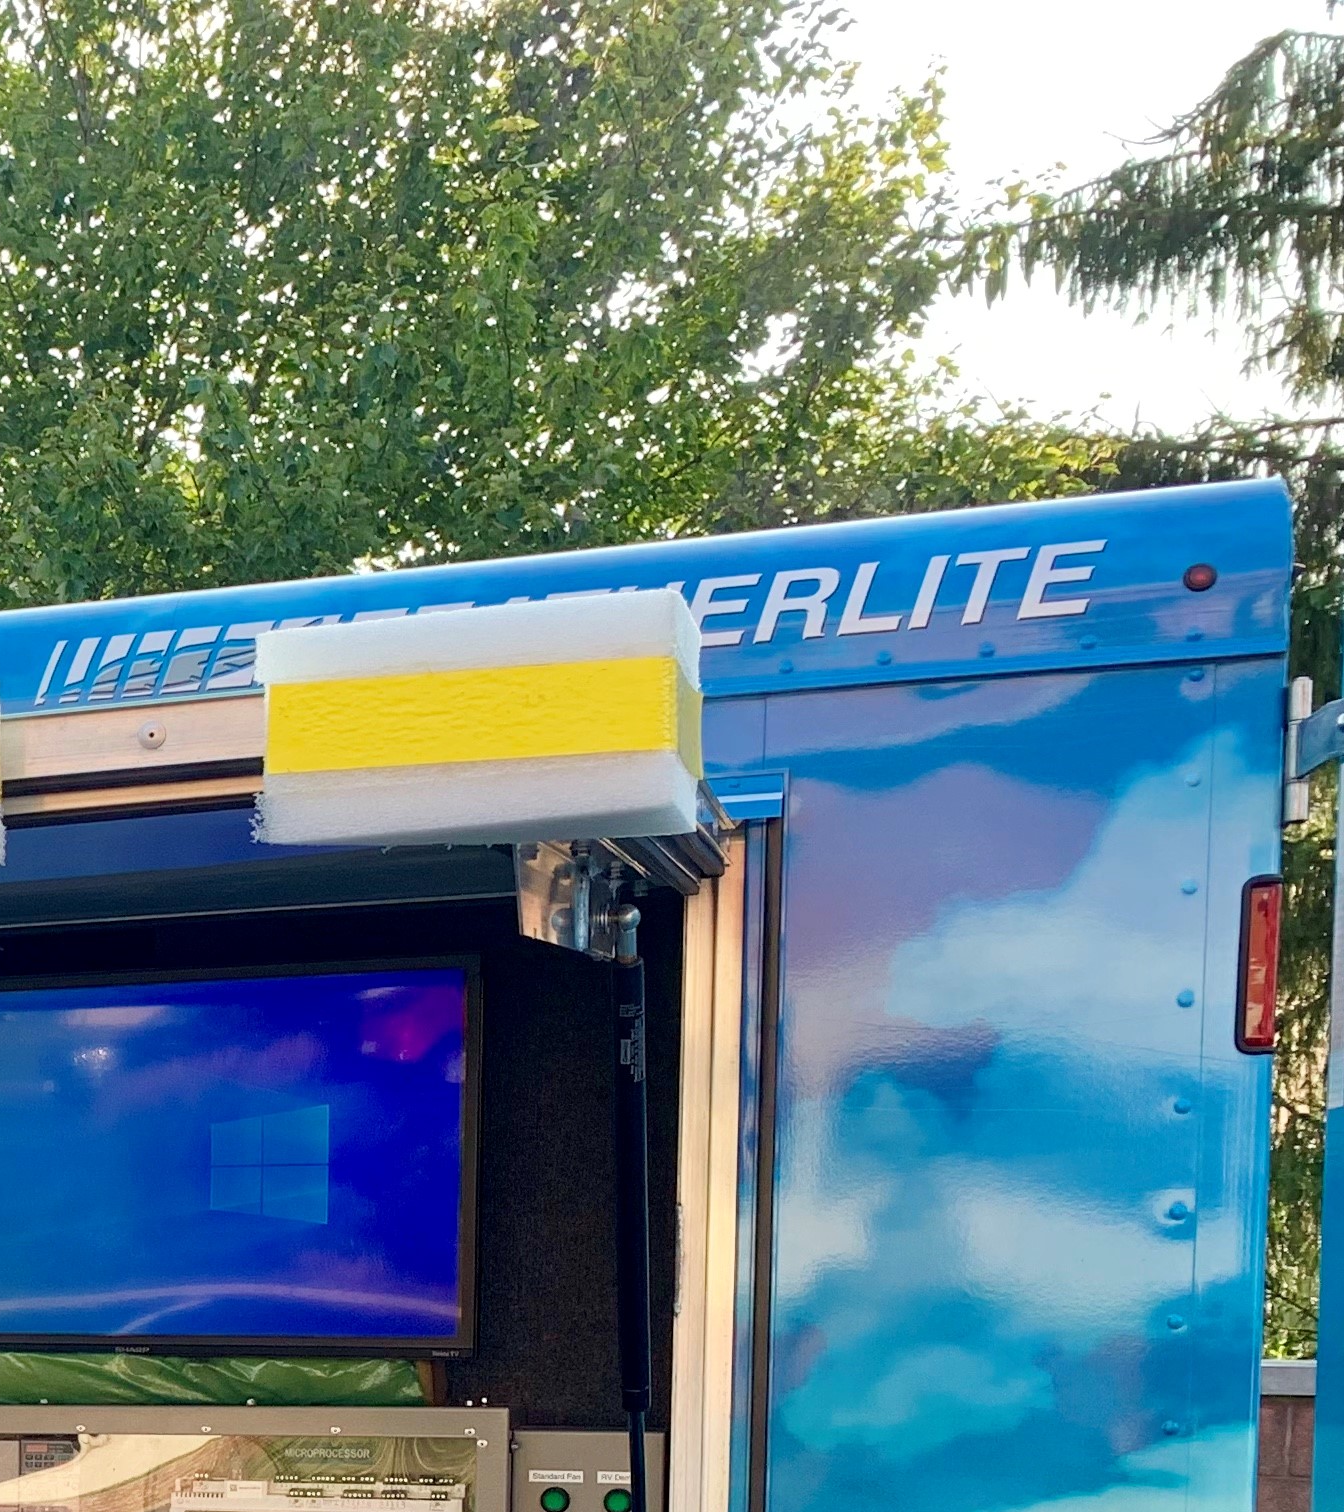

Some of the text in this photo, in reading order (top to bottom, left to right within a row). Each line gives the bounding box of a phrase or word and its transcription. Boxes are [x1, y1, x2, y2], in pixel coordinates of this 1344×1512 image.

[350, 539, 1108, 648] ERLITE
[284, 1448, 370, 1459] MICROPROCESSOR
[532, 1472, 565, 1480] Standard
